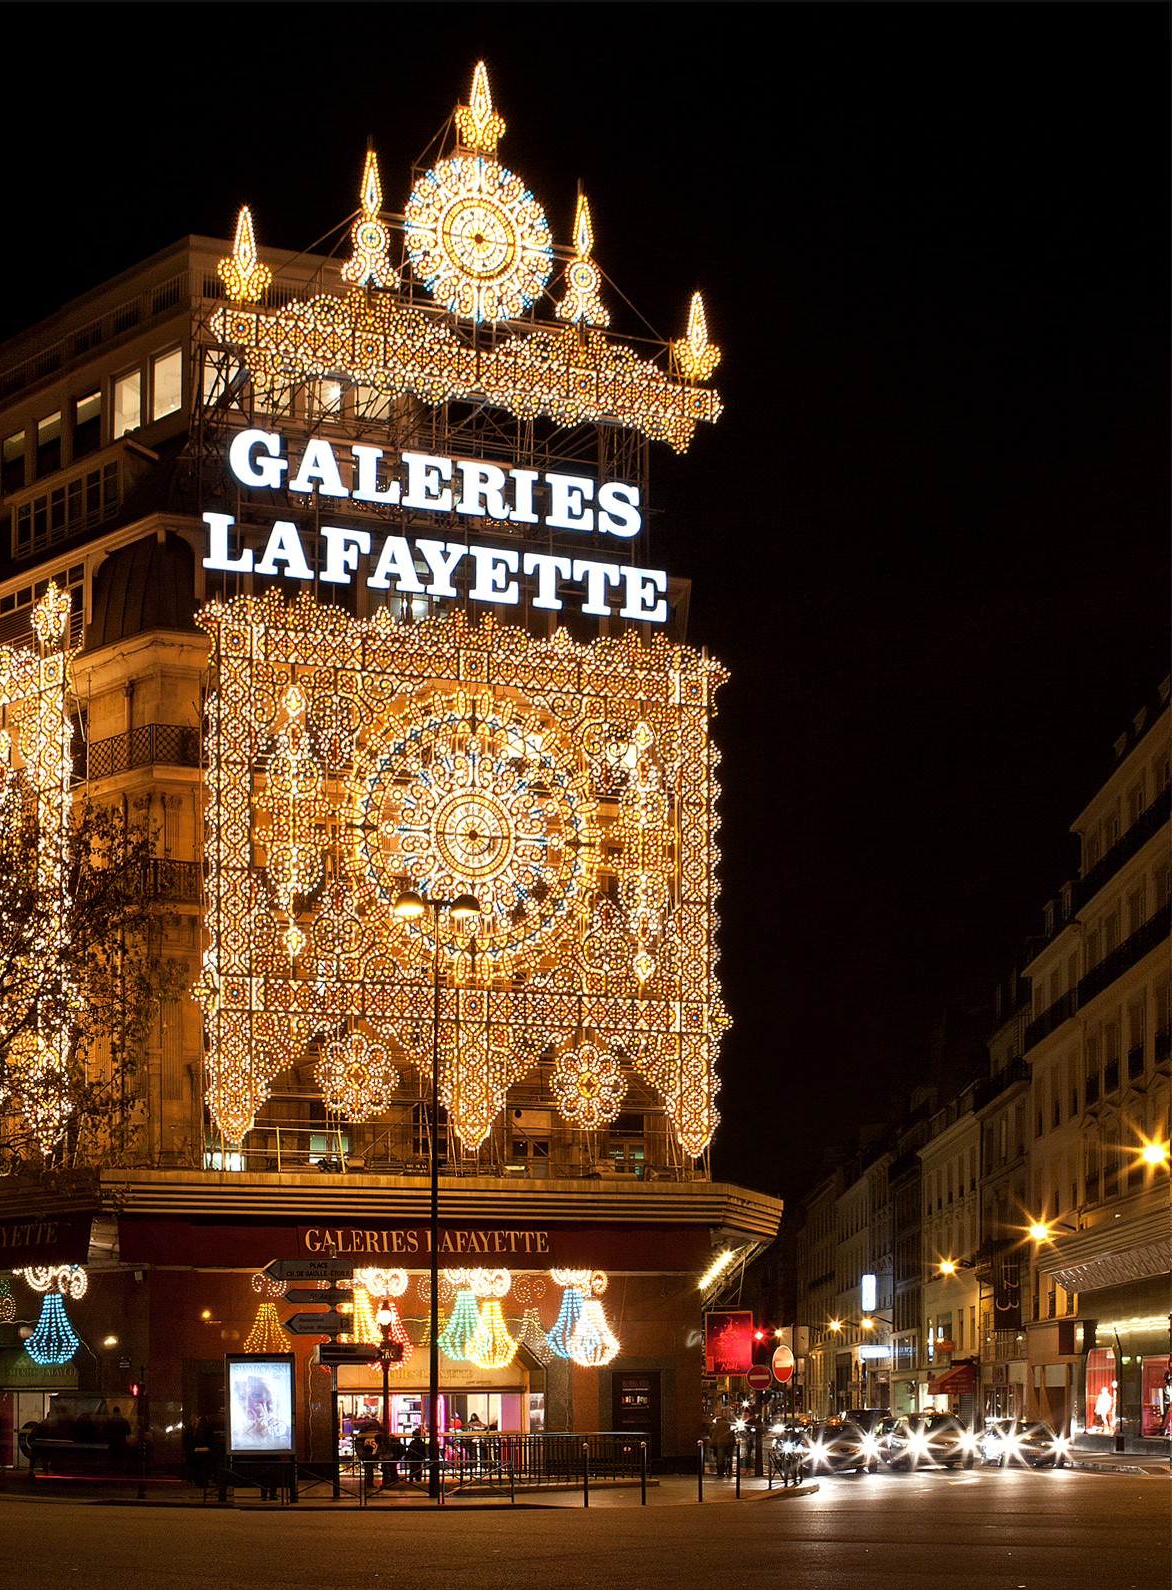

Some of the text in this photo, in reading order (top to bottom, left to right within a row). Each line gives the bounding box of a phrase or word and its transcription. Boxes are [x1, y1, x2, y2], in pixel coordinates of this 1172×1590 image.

[229, 429, 641, 537] GALERIES
[203, 512, 667, 623] LAFAYETTE
[305, 1228, 549, 1254] GALERIES LAFAYETTE
[233, 1364, 288, 1374] SWAROVSKI
